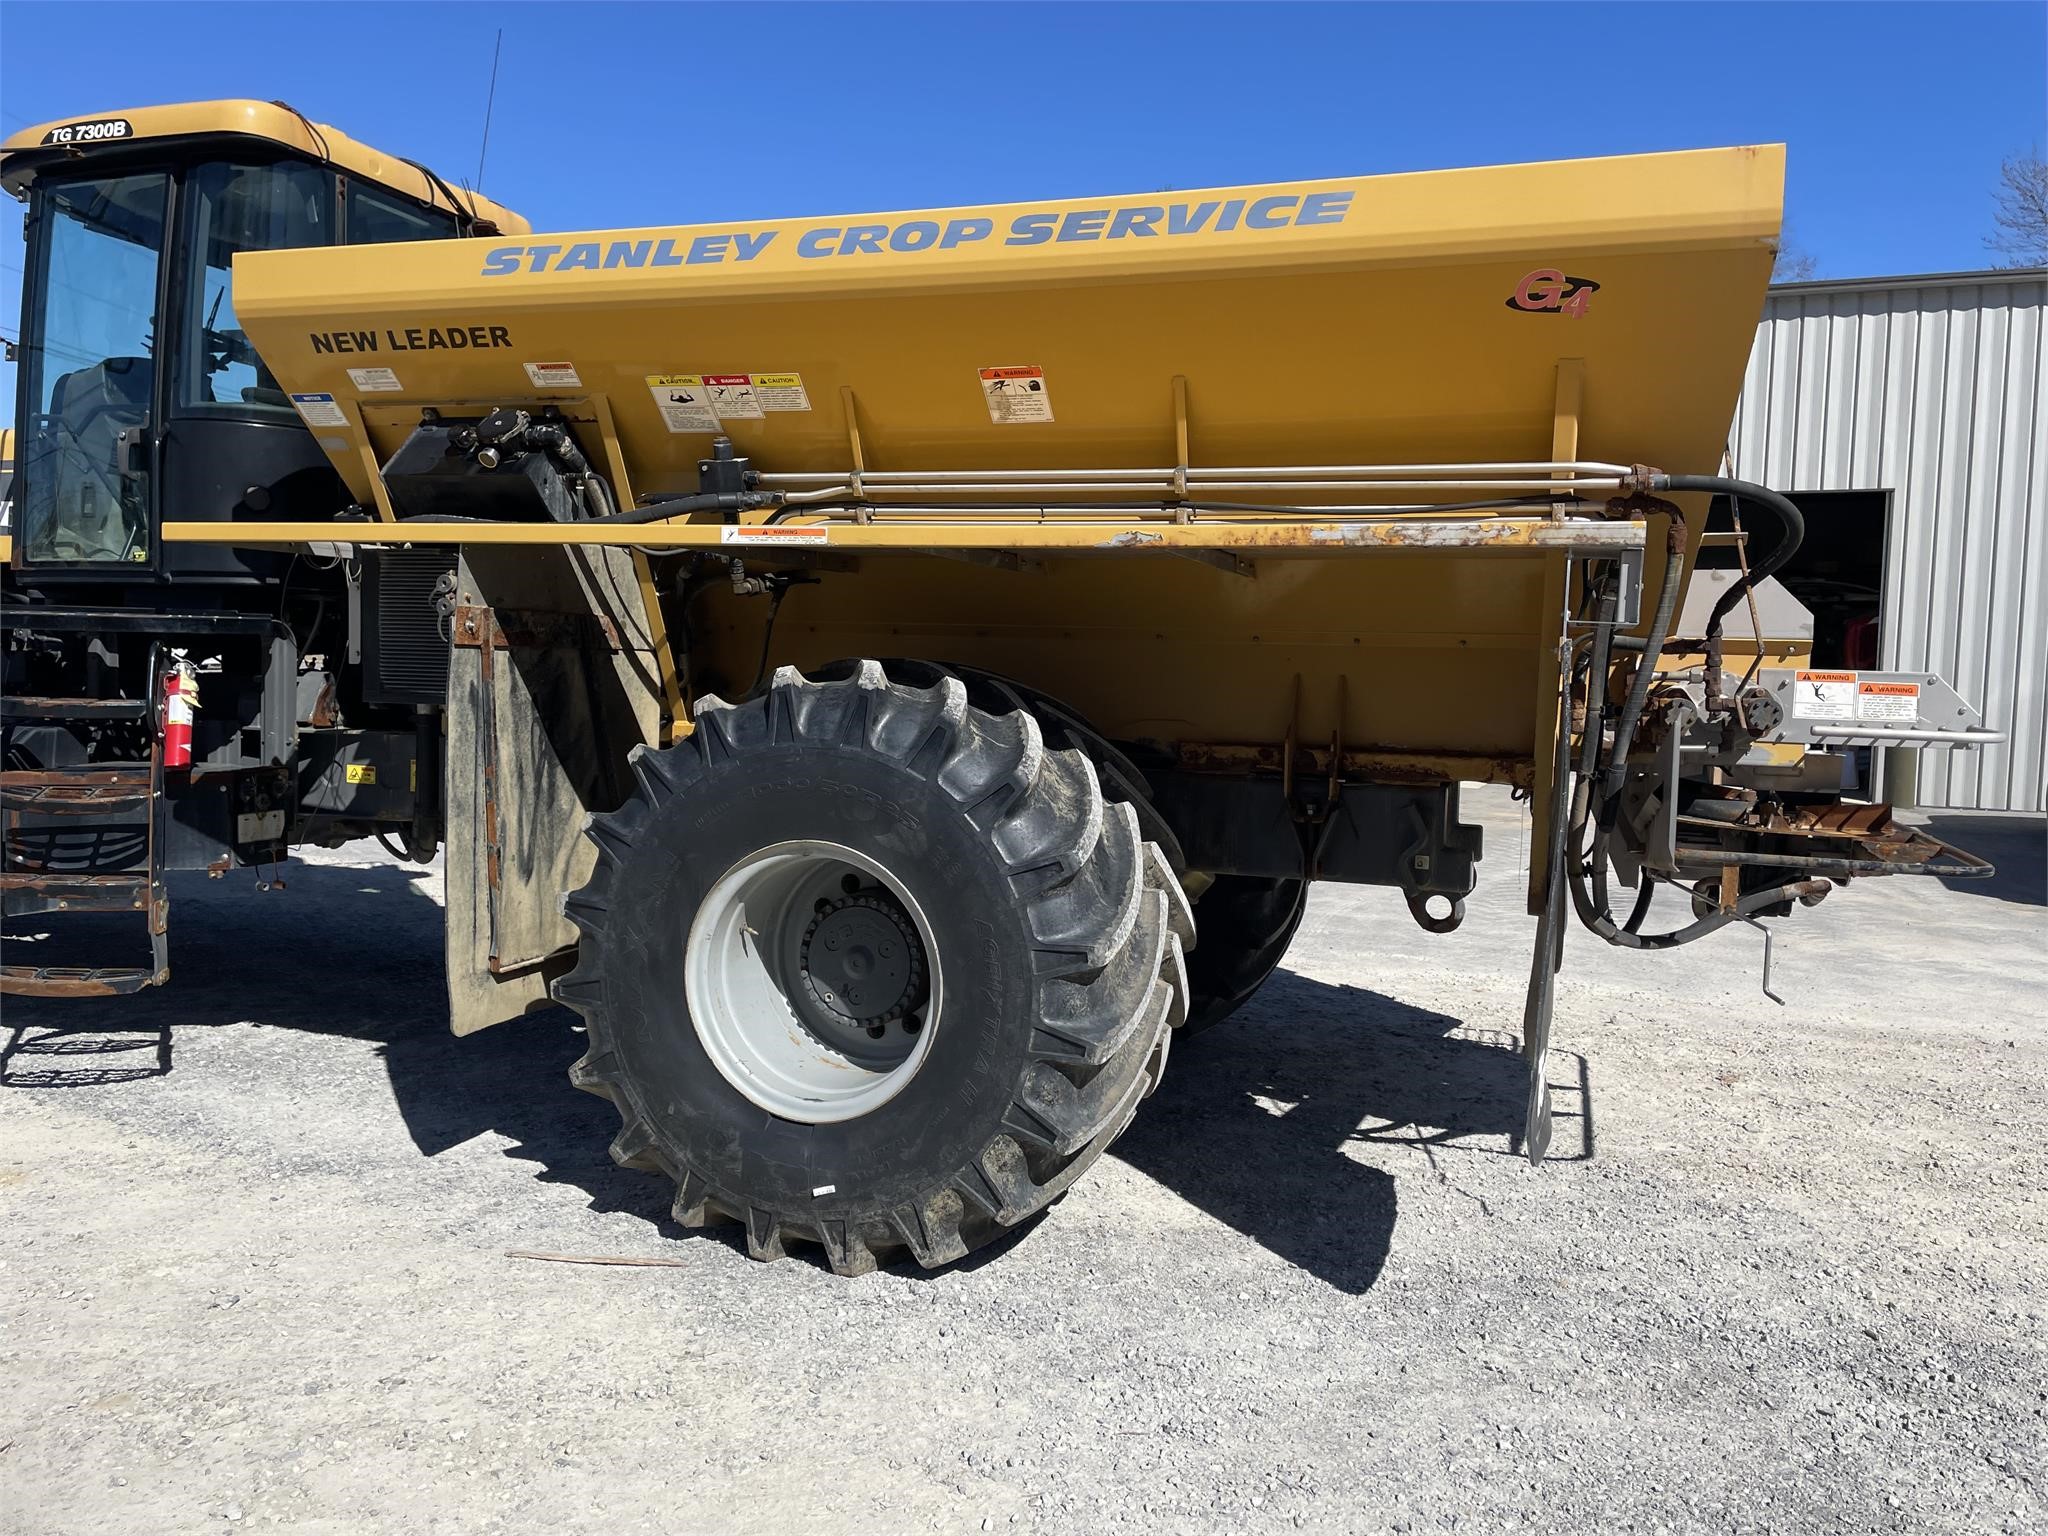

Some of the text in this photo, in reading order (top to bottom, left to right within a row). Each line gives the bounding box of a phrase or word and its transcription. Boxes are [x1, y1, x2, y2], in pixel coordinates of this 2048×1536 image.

[51, 121, 126, 143] TG 7300B
[481, 191, 1356, 277] STANLEY CROP SERVICE
[1514, 268, 1593, 320] G4
[310, 326, 513, 354] NEW LEADER
[1815, 673, 1850, 681] WARNING
[1878, 686, 1914, 694] WARNING
